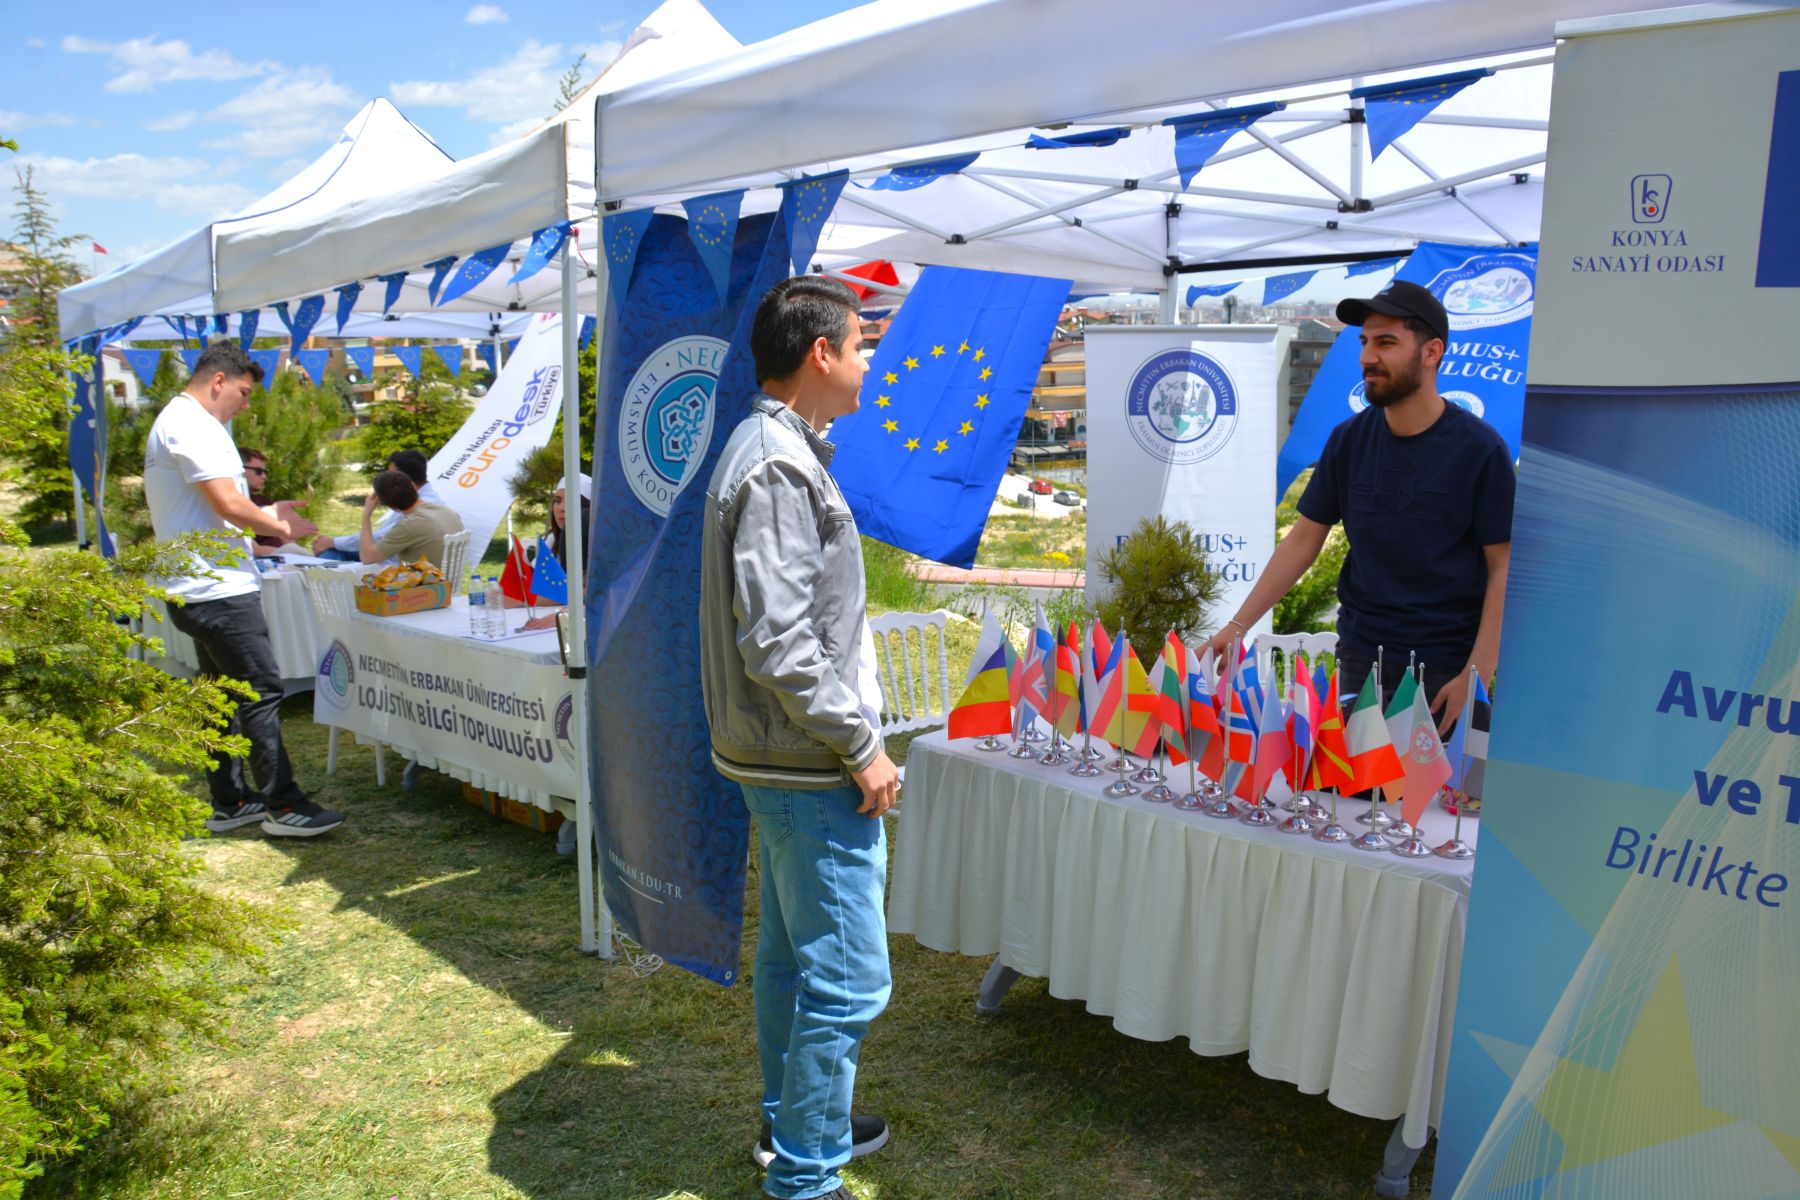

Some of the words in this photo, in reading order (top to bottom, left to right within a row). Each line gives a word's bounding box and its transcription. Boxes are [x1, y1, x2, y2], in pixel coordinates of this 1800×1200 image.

[1571, 254, 1650, 272] SANAYİ
[1656, 255, 1726, 272] ODASI
[1612, 229, 1688, 247] KONYA
[534, 369, 559, 417] Türkiye
[1160, 358, 1197, 371] ERBAKAN
[437, 452, 472, 481] Temas
[470, 418, 504, 453] Noktası
[457, 366, 547, 489] eurodesk
[626, 372, 660, 464] ERASMUS
[359, 653, 409, 686] NECMETTİN
[410, 671, 464, 699] ERBAKAN
[466, 678, 546, 722] ÜNİVERSİTESİ
[1655, 669, 1800, 736] Avru
[358, 684, 416, 722] LOJİSTİK
[416, 699, 458, 734] BİLGİ
[459, 713, 554, 763] TOPLULUĞU
[1693, 769, 1762, 816] ve
[1605, 826, 1789, 908] Birlikte
